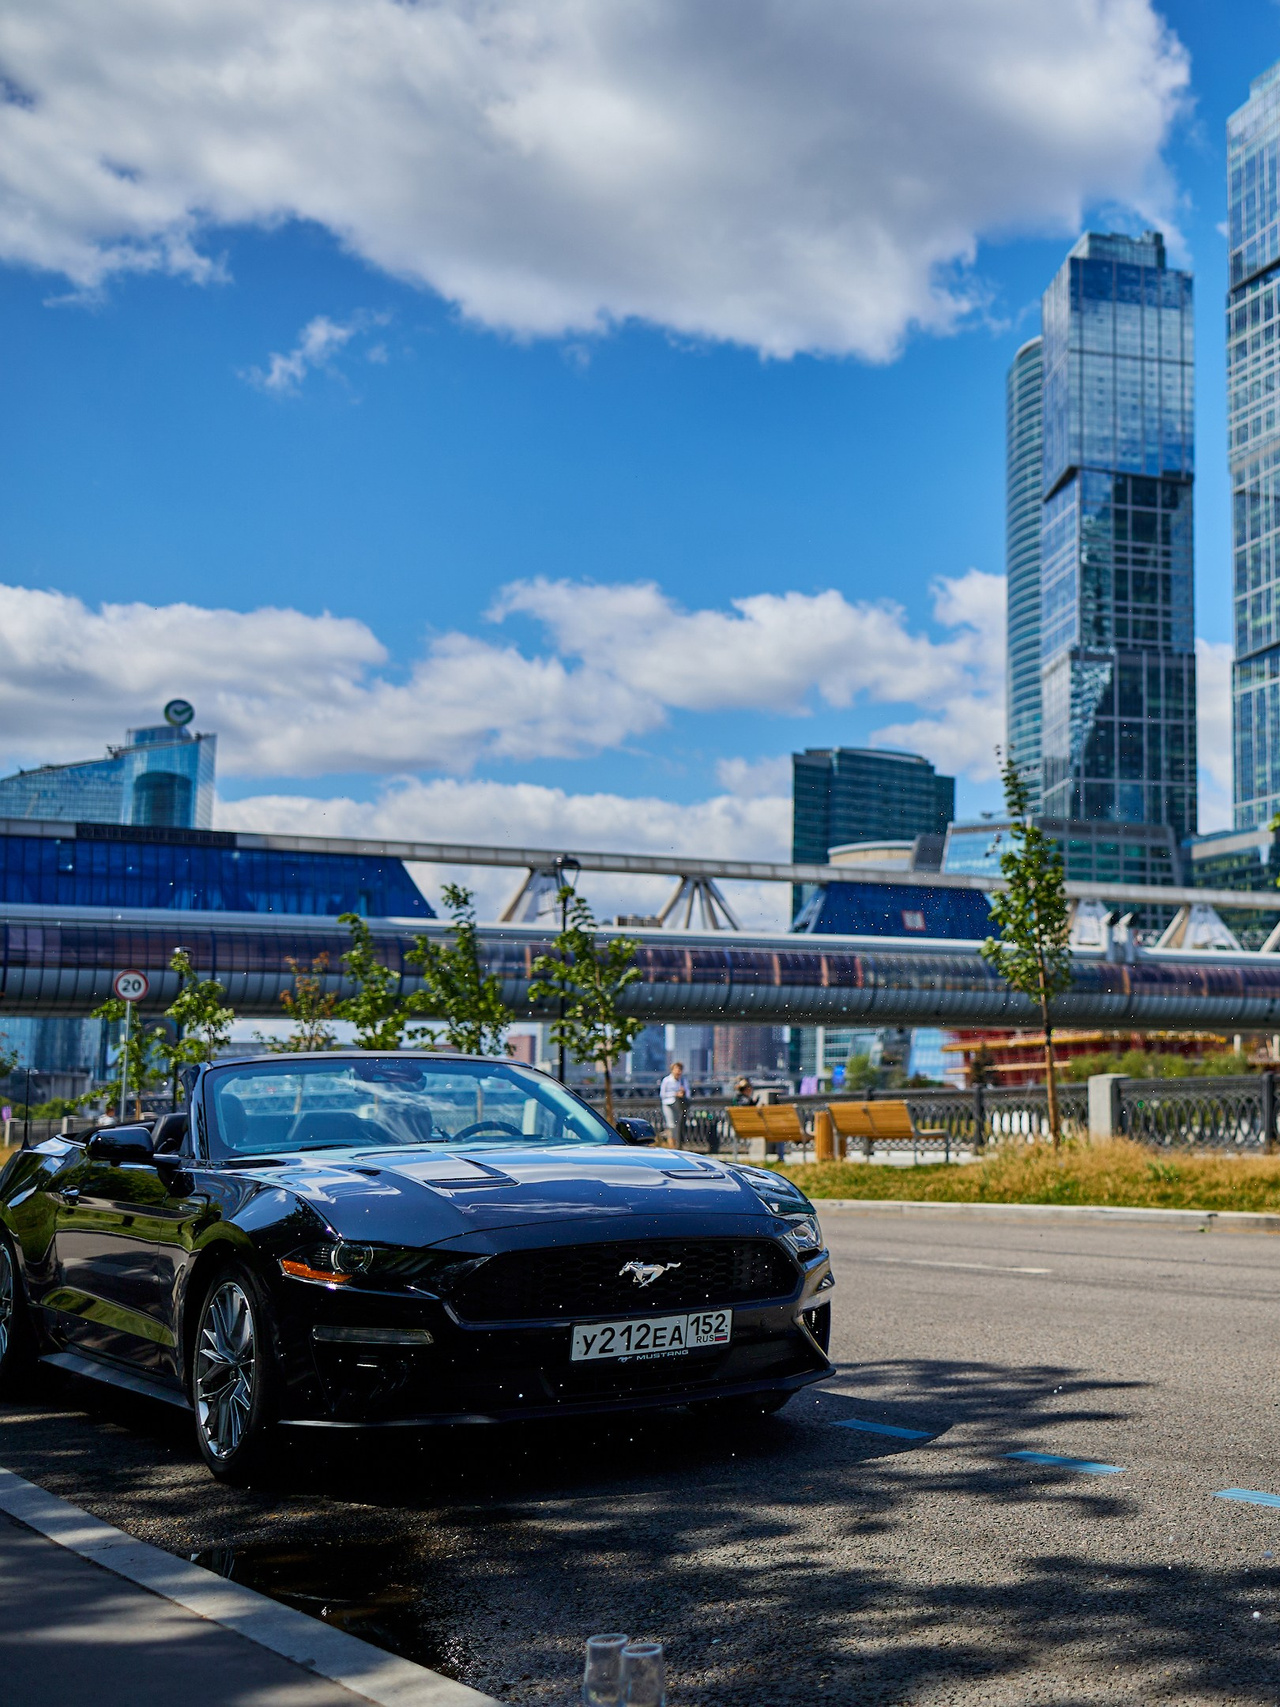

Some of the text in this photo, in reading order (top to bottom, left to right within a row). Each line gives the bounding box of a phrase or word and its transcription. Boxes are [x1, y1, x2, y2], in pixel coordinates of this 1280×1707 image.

[122, 978, 142, 993] 20
[690, 1313, 726, 1336] 152
[696, 1334, 715, 1344] RUS
[636, 1349, 689, 1361] MUSTANG
